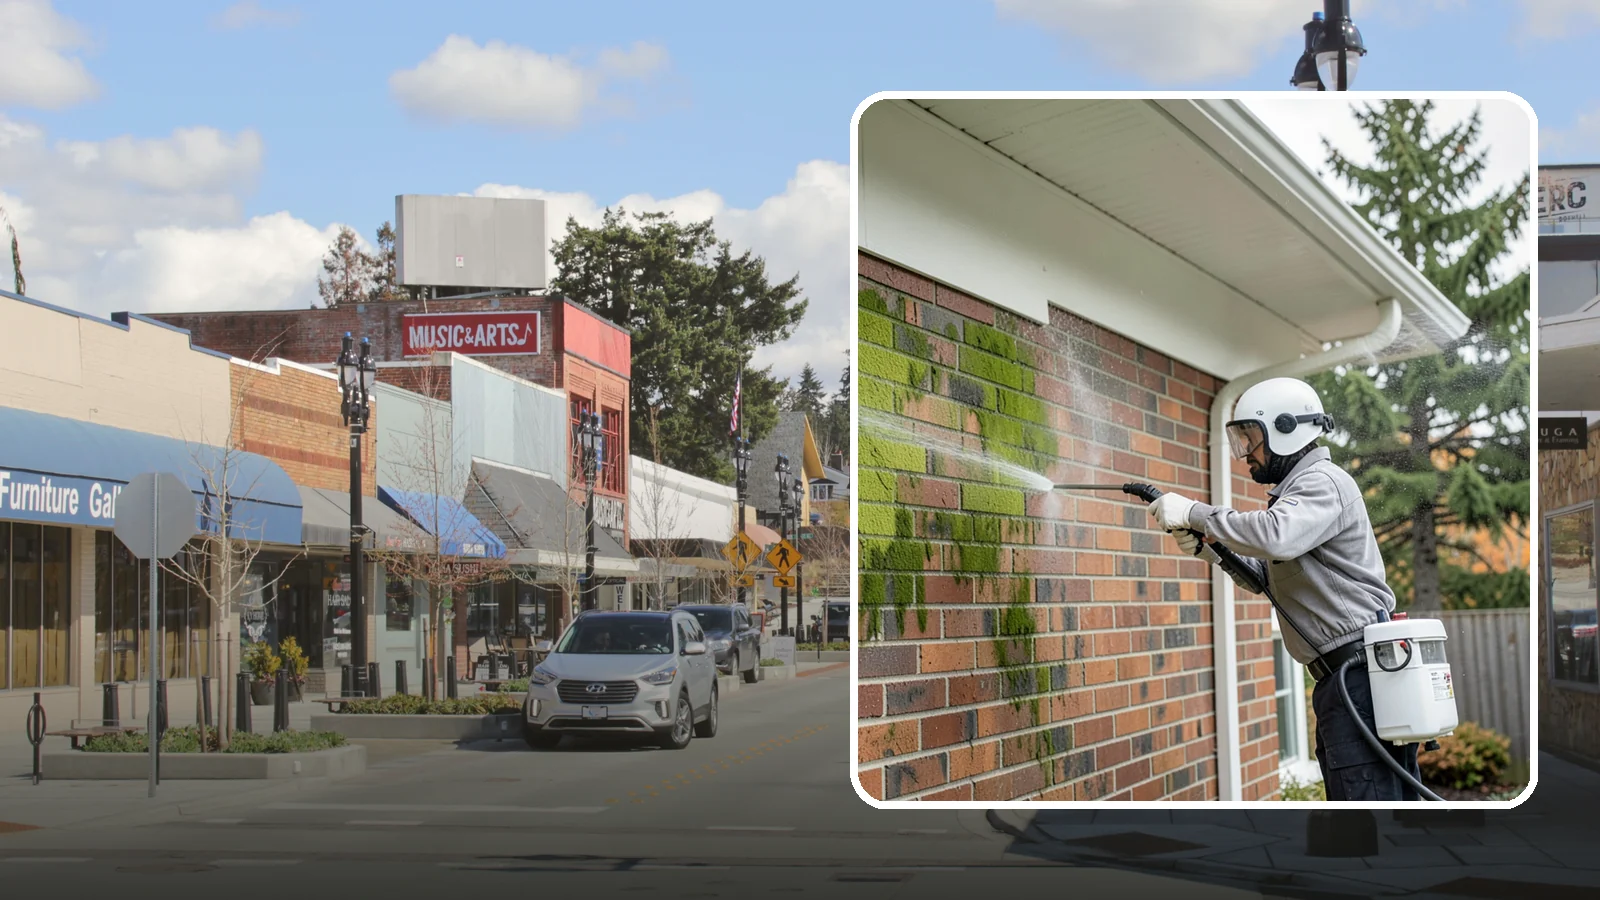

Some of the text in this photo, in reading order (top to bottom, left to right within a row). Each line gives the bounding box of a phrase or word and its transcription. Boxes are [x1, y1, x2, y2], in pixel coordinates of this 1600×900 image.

[408, 323, 520, 349] MUSIC&ARTS
[0, 471, 122, 519] Furniture Gal
